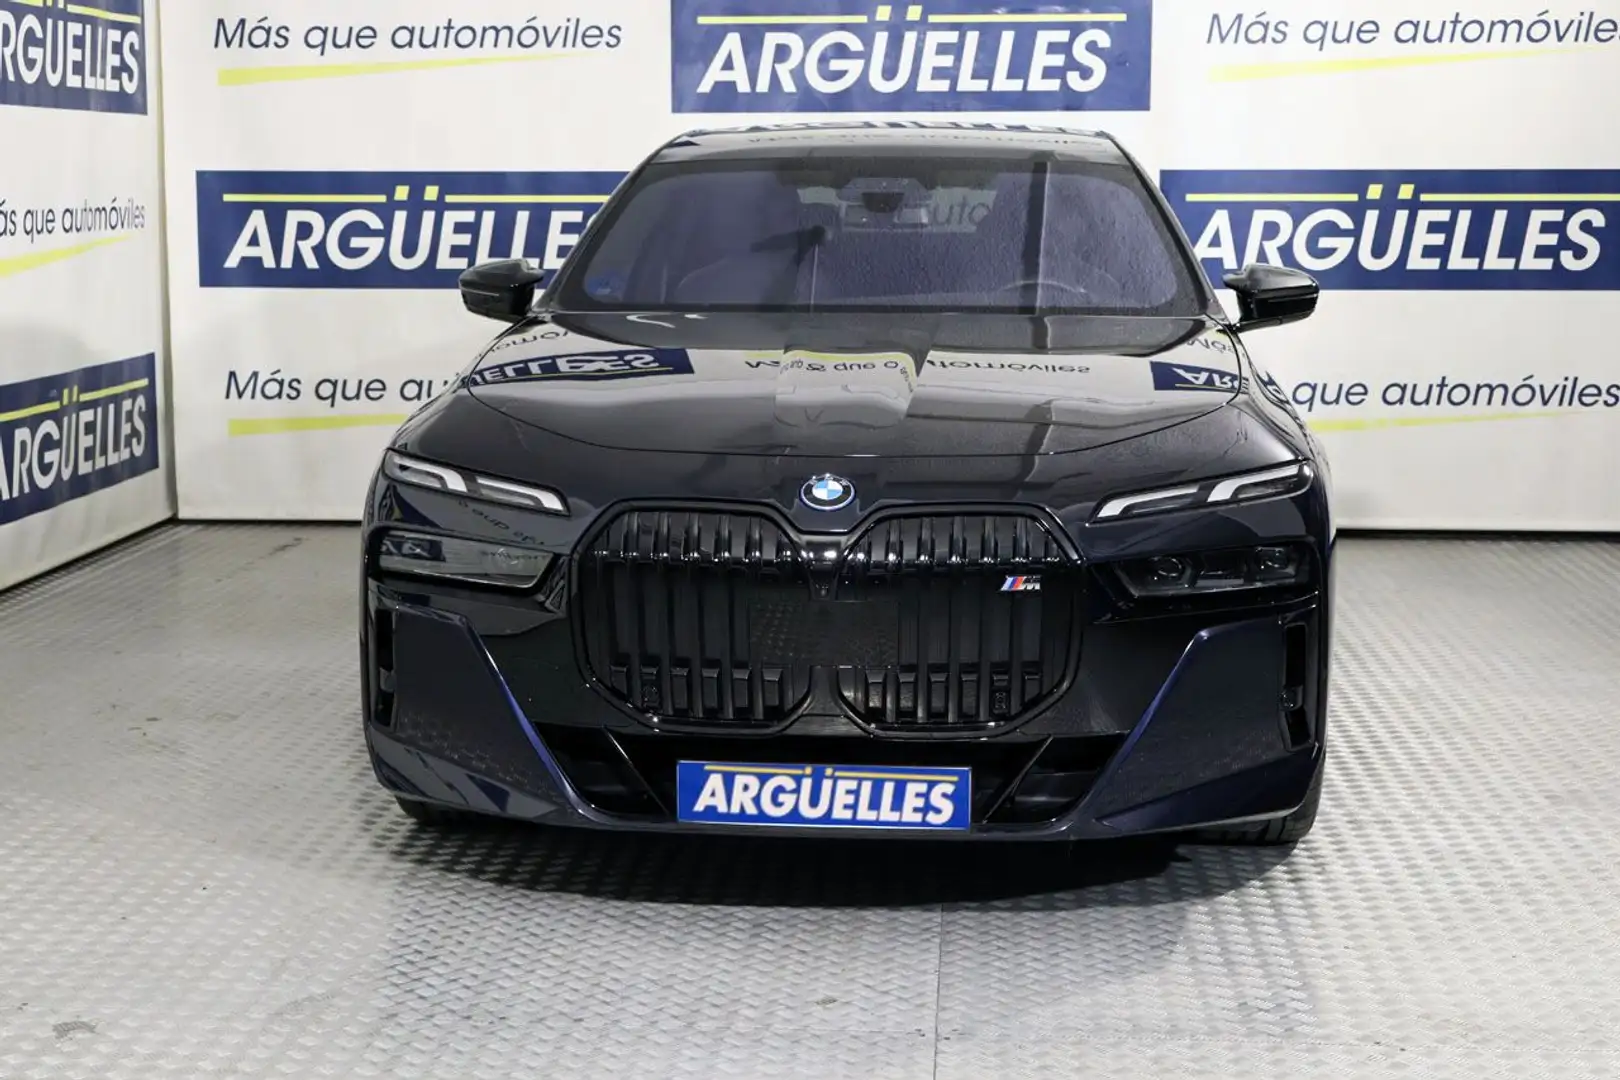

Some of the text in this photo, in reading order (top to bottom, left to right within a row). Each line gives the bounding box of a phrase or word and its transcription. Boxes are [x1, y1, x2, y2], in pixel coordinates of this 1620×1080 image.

[0, 0, 139, 94] RGÜELLES
[214, 16, 622, 56] Más que automóviles
[696, 5, 1111, 94] ARGÜELLES
[1206, 9, 1620, 51] Más que automóvile
[0, 197, 145, 244] ás que automóviles
[223, 185, 599, 270] ARGÜELLE
[1194, 184, 1606, 271] ARGÜELLES
[225, 369, 301, 400] Más
[314, 378, 386, 408] que
[1292, 374, 1620, 412] que automóviles
[692, 766, 955, 825] ARGÜELLES
